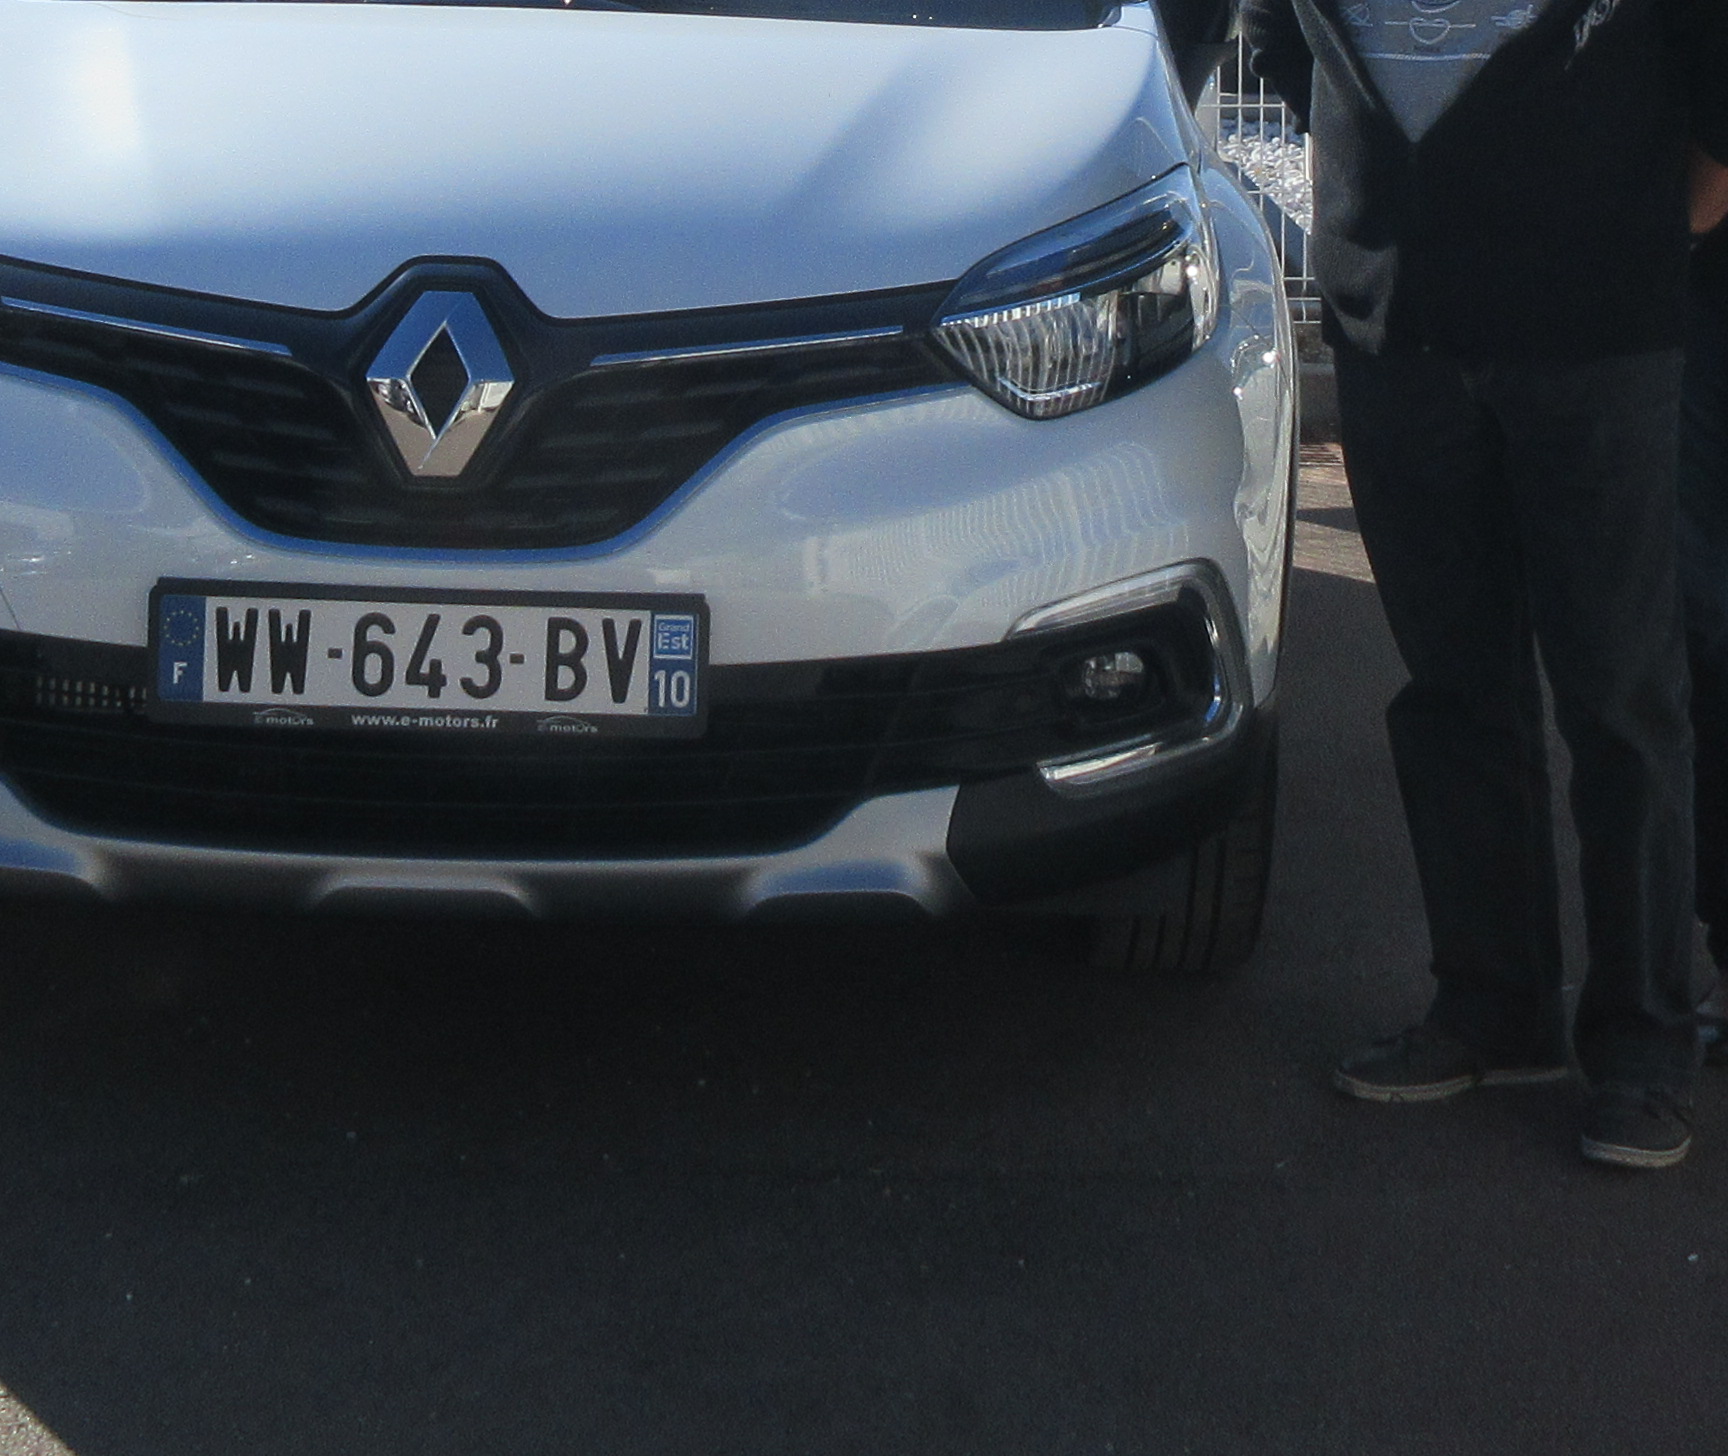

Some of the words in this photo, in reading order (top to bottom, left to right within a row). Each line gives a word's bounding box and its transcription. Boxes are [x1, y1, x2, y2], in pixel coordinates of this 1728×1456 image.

[657, 632, 690, 650] Est
[173, 662, 188, 684] F
[654, 670, 691, 708] 10
[351, 713, 499, 728] www.e-motors.fr
